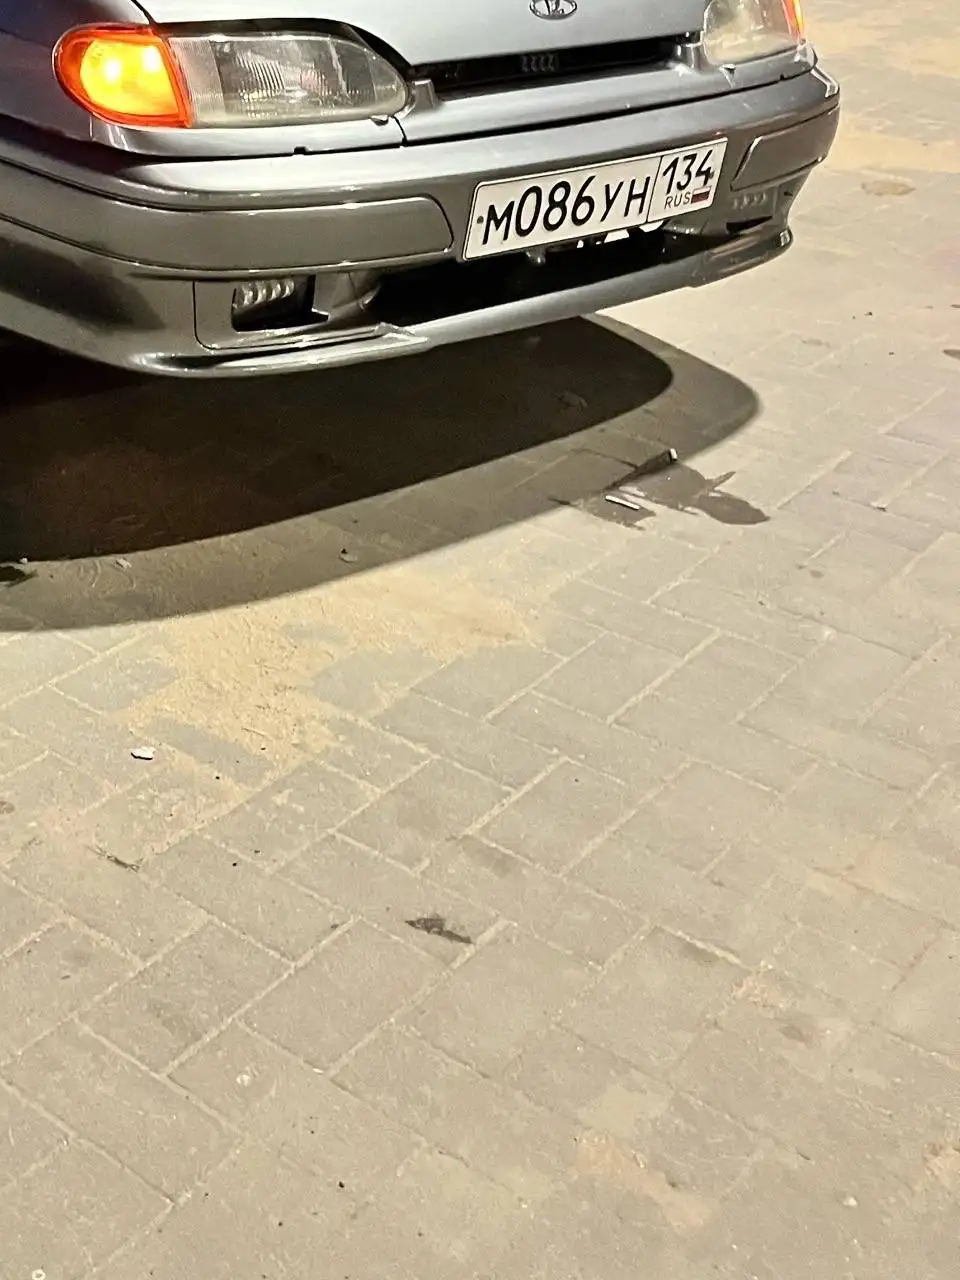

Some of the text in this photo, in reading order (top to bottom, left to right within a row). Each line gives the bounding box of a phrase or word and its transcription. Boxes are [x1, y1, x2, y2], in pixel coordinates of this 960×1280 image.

[482, 149, 713, 245] М086УН 134
[664, 191, 691, 209] RUS
